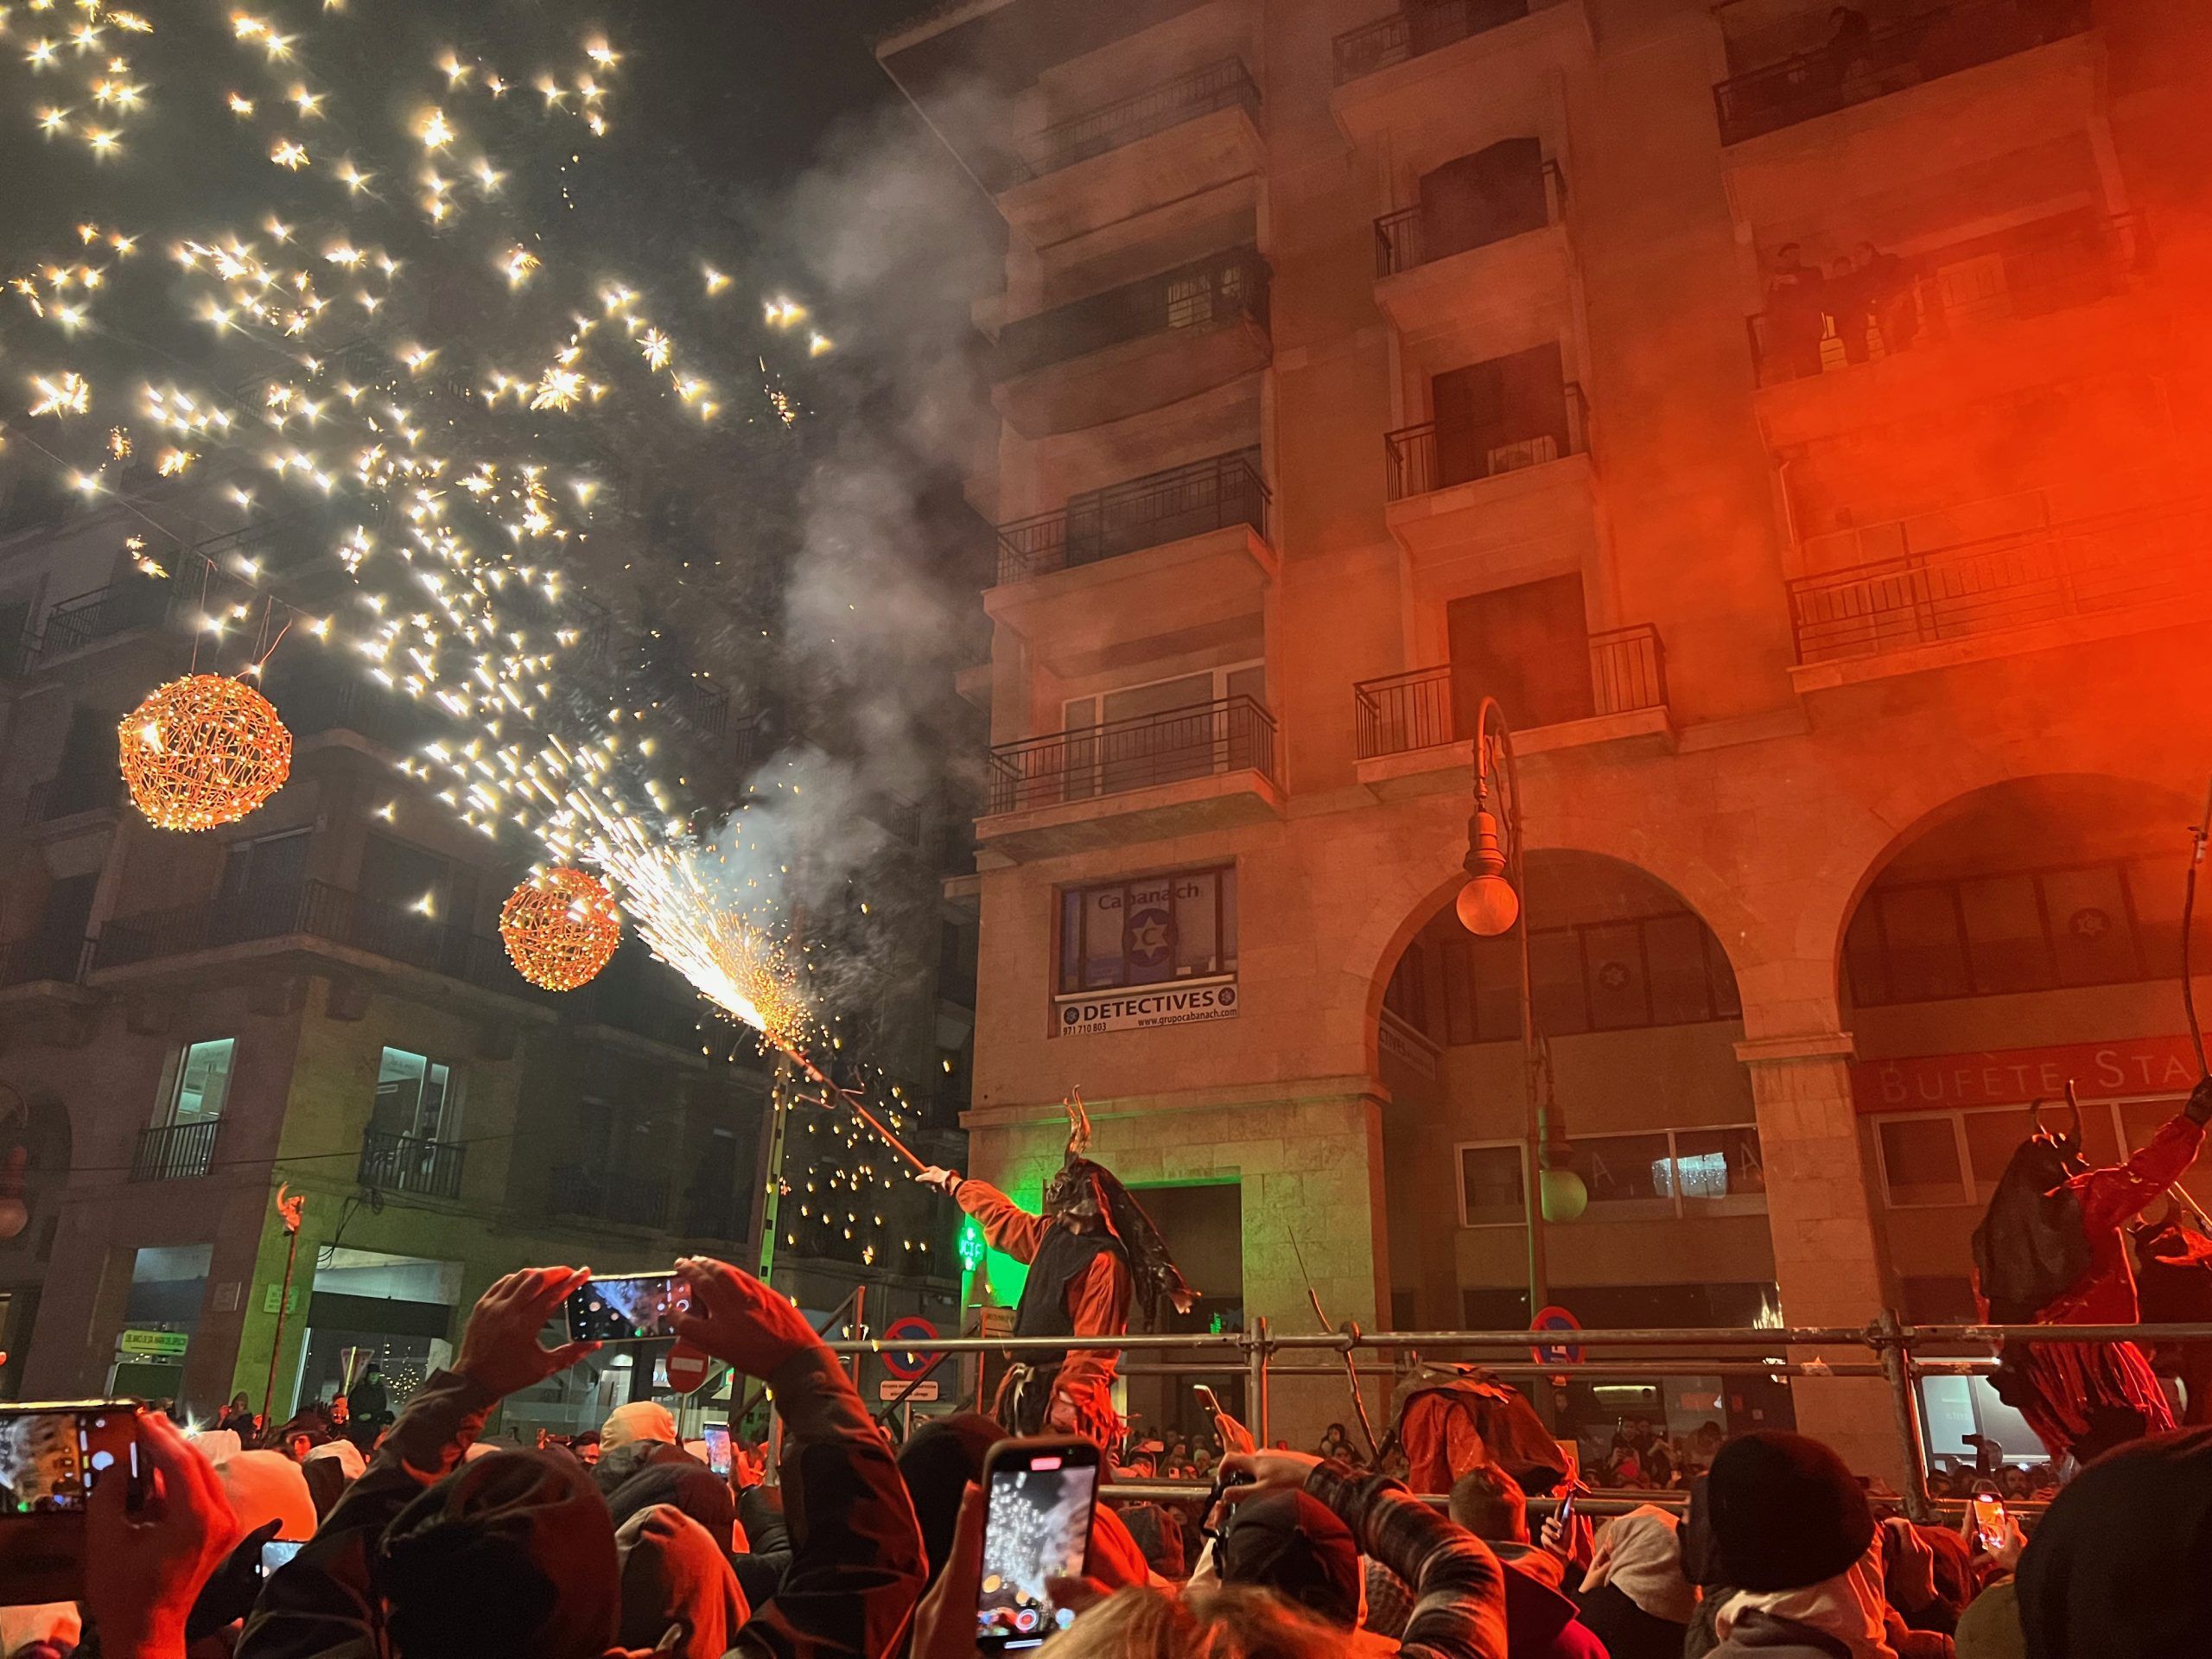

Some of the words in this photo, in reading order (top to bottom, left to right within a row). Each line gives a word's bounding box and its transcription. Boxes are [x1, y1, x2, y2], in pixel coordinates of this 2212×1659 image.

[1084, 990, 1214, 1021] DETECTIVES
[1137, 1007, 1237, 1027] www.grupocabanach.com
[1063, 1025, 1076, 1036] 971
[1077, 1024, 1091, 1034] 710
[1093, 1022, 1107, 1033] 803
